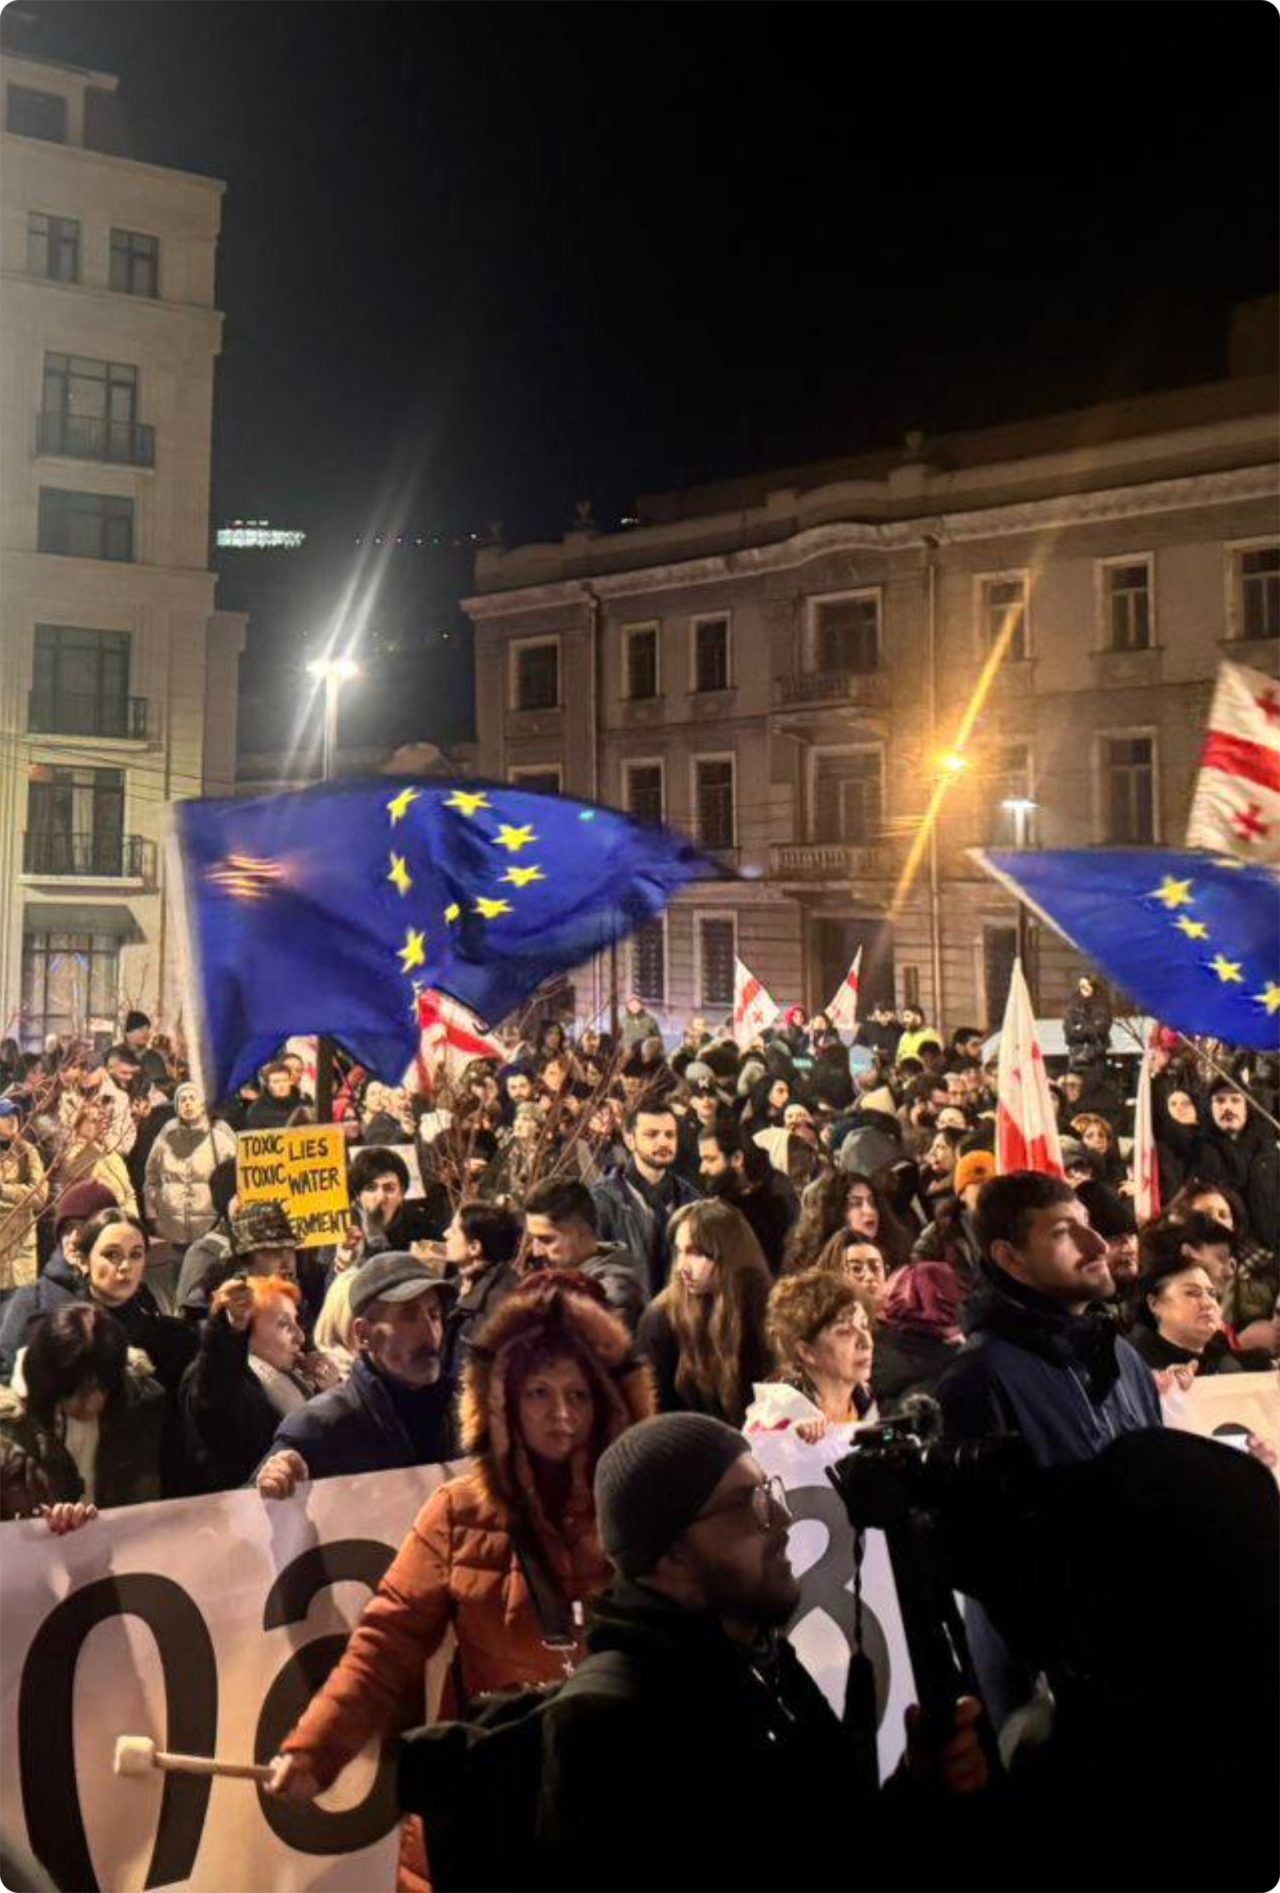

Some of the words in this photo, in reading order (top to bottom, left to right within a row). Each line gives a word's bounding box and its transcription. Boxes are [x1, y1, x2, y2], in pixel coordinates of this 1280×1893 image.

[240, 1135, 284, 1158] TOXIC
[288, 1139, 329, 1161] LIES
[241, 1163, 288, 1189] TOXIC
[288, 1167, 340, 1197] WATER
[287, 1209, 350, 1239] ERNMENT
